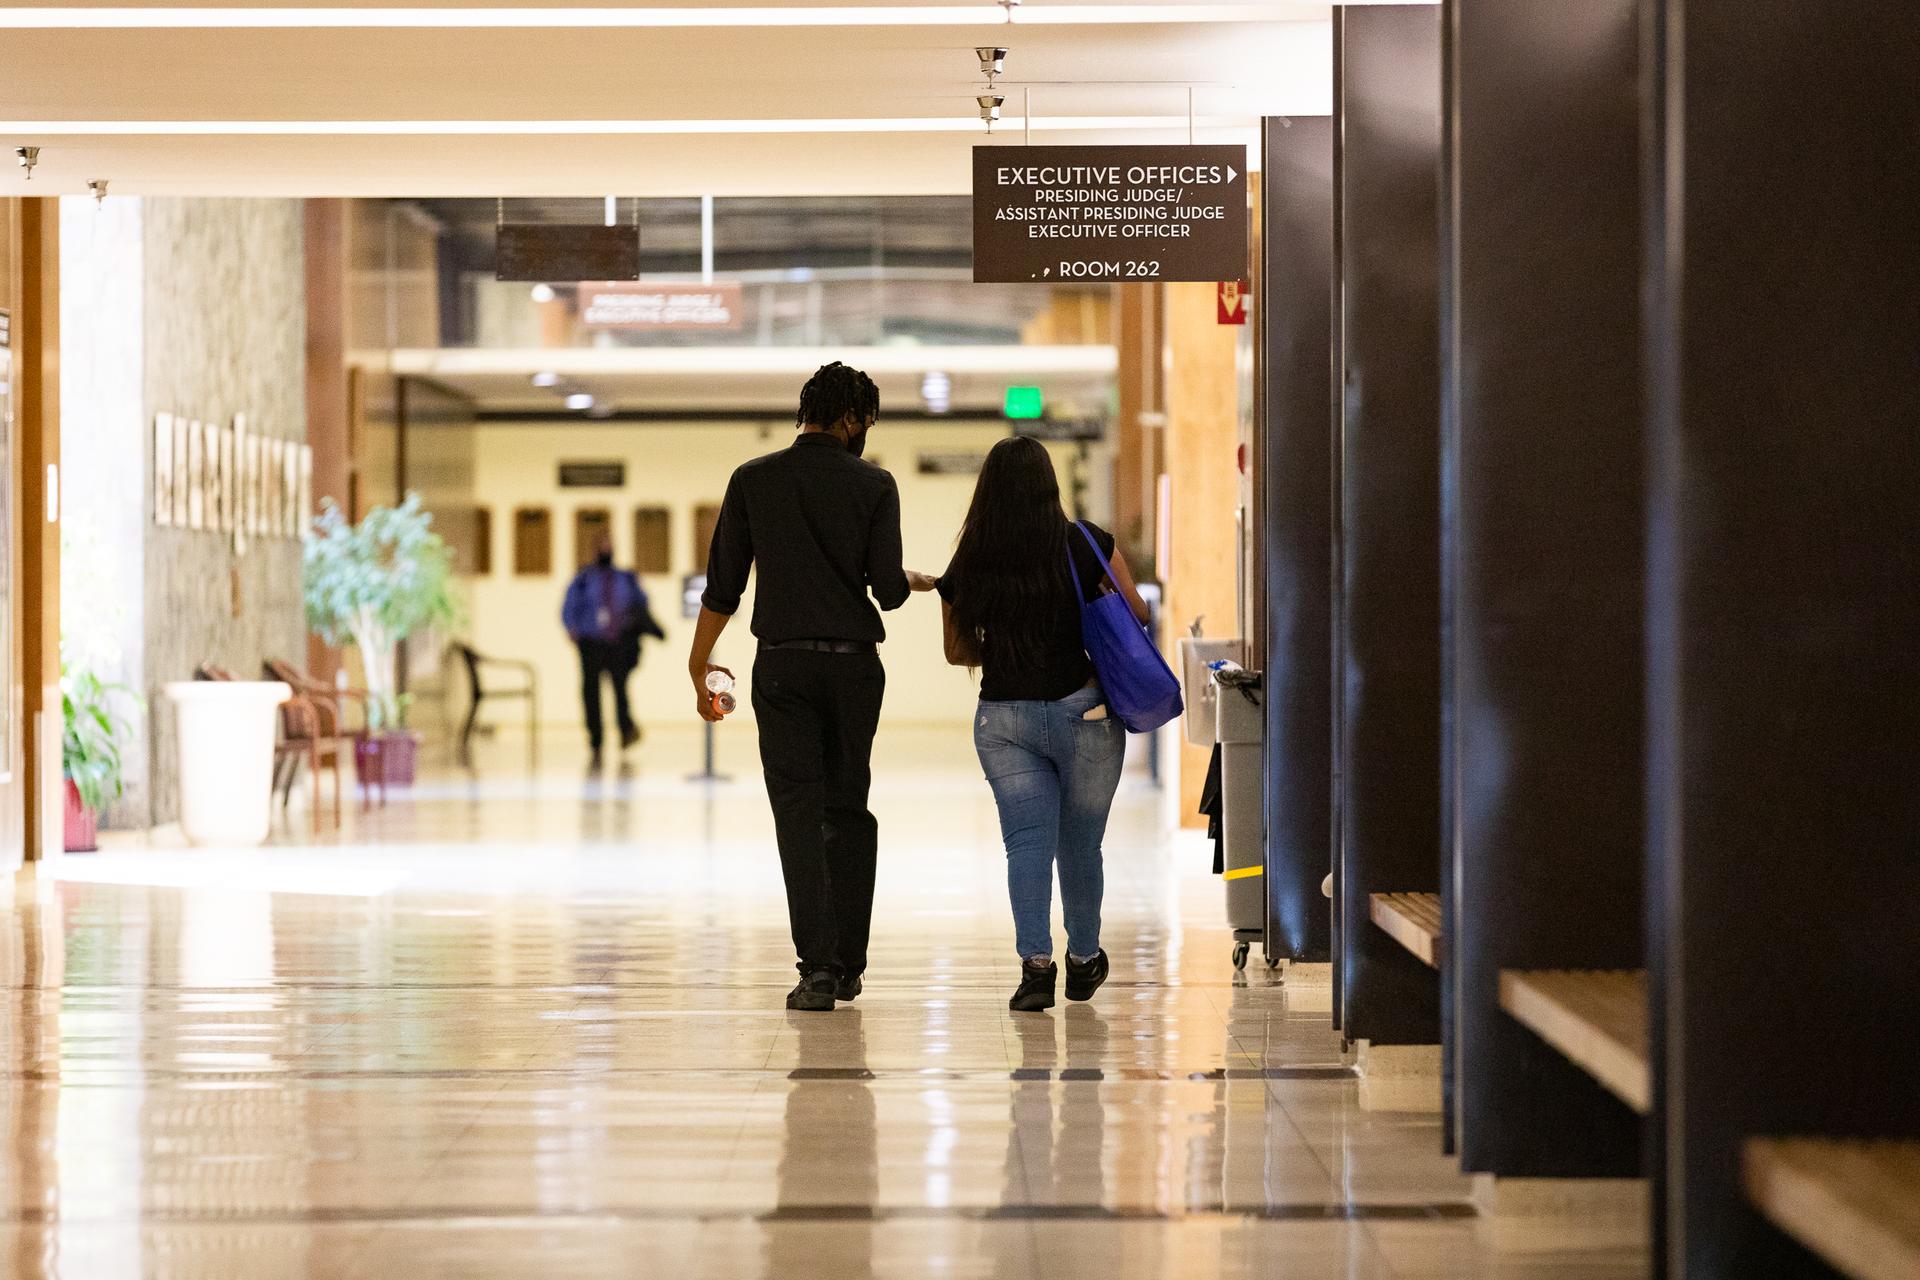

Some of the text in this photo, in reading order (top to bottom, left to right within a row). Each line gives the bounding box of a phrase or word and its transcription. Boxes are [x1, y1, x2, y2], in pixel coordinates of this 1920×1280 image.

[997, 165, 1222, 185] EXECUTIVE OFFICES
[1034, 187, 1184, 204] PRESIDING JUDGE/
[995, 205, 1225, 221] ASSISTANT PRESIDING JUDGE
[1028, 224, 1191, 238] EXECUTIVE OFFICER
[1059, 260, 1160, 277] ROOM 262
